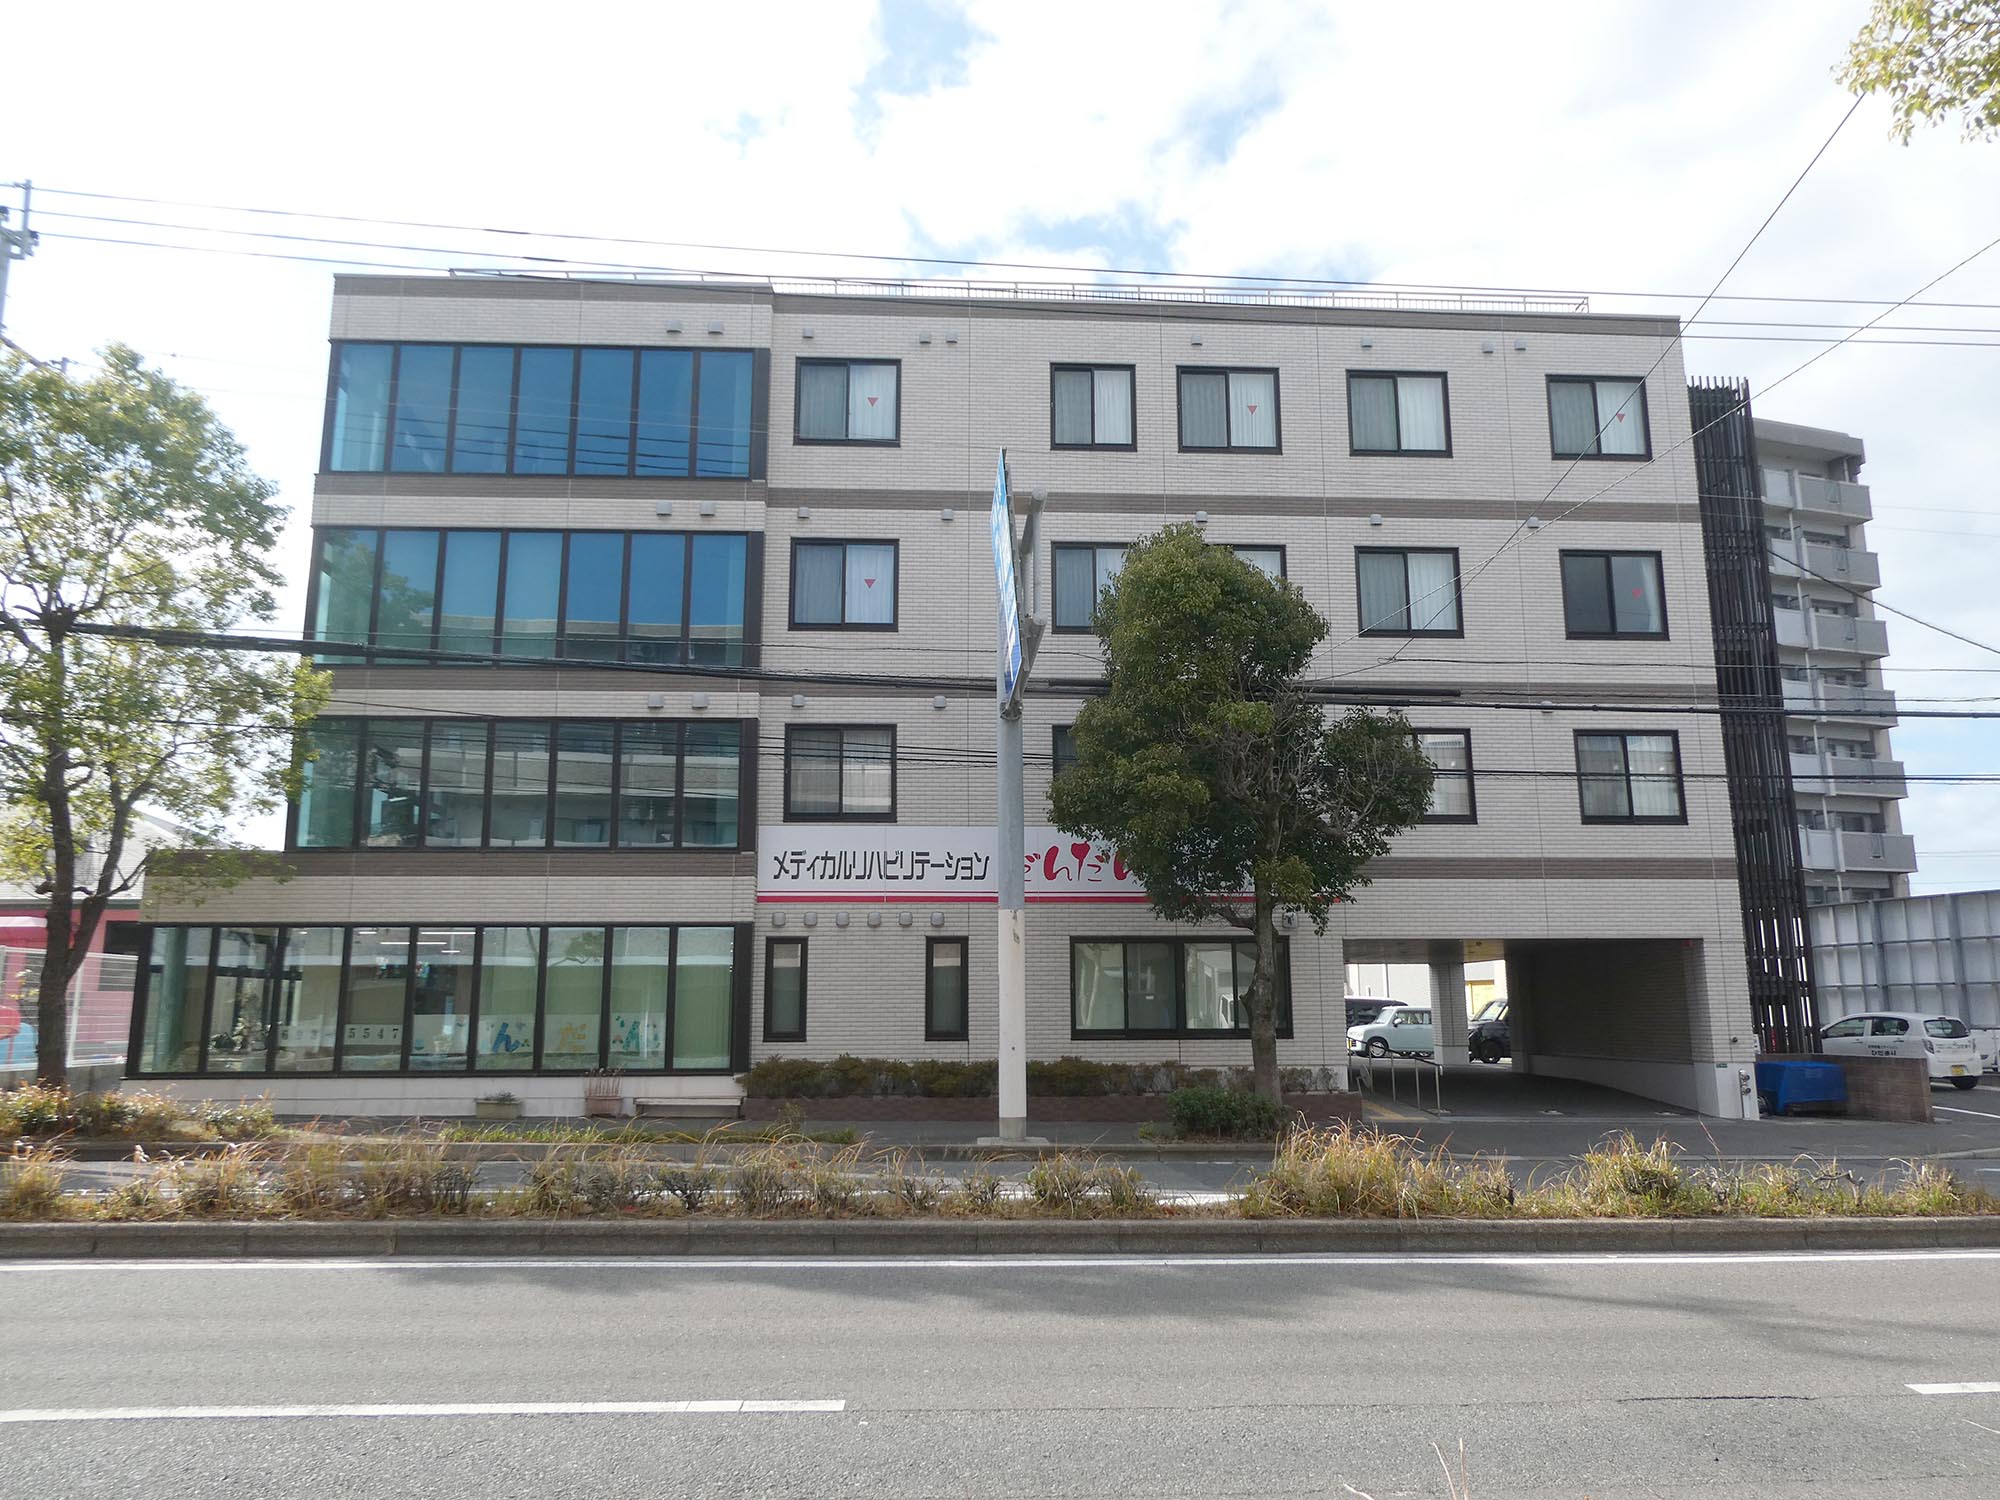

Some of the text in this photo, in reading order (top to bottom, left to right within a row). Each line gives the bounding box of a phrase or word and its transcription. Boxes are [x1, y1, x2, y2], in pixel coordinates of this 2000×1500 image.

[773, 850, 990, 880] メディカルリハビリテーション
